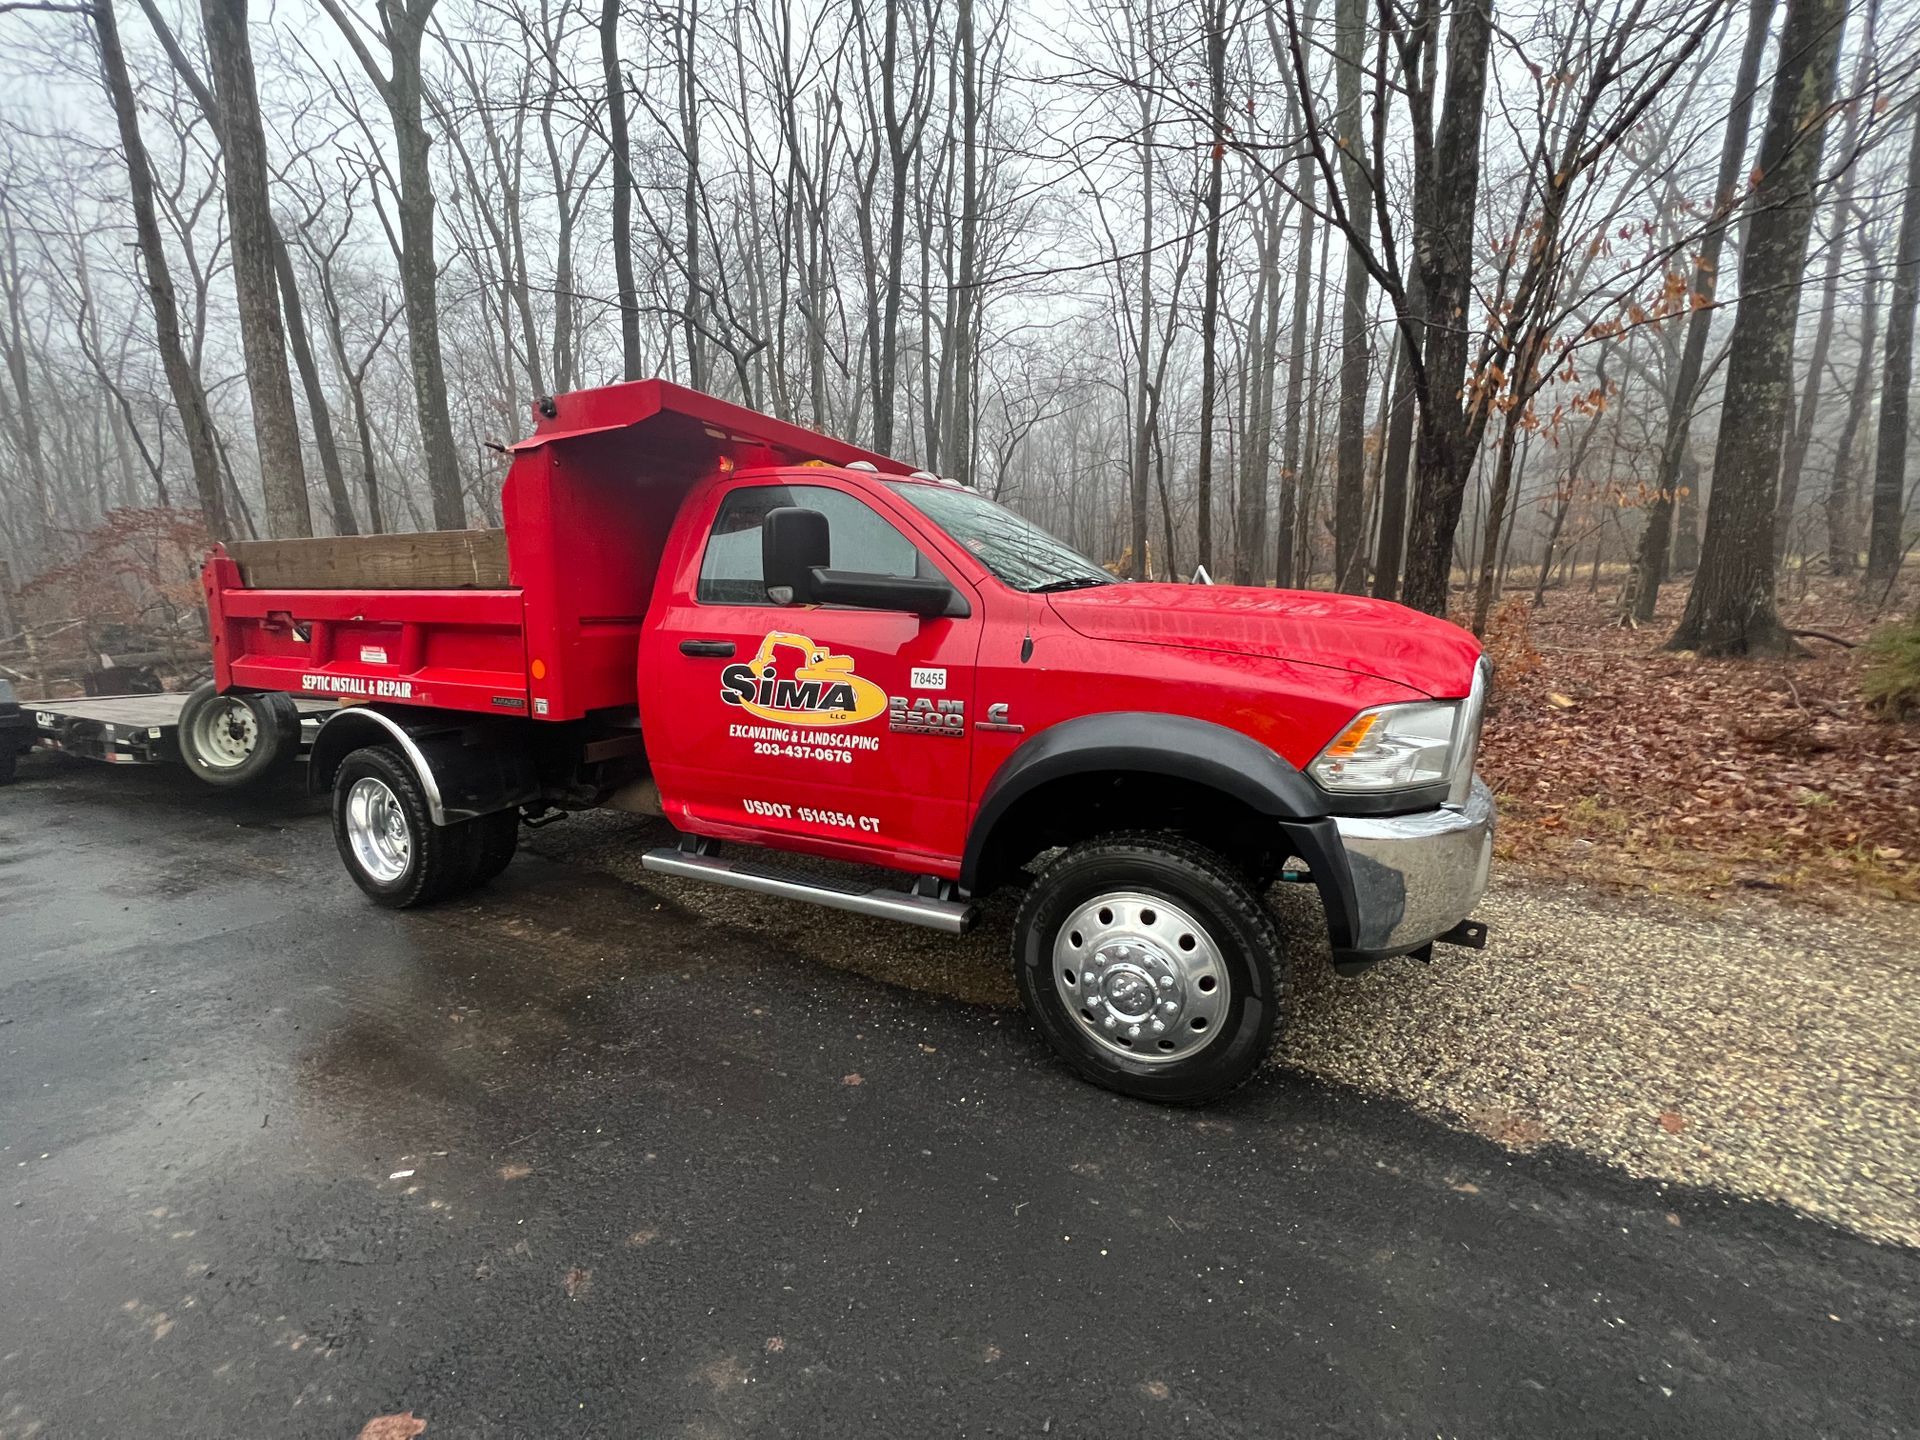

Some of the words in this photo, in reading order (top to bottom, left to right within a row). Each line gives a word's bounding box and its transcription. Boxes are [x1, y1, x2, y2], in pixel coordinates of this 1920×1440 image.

[302, 674, 330, 691] SEPTIC
[331, 676, 366, 694] INSTALL
[368, 680, 375, 695] &
[377, 681, 412, 698] REPAIR
[914, 672, 944, 685] 78455
[889, 696, 964, 714] RAM
[889, 709, 964, 728] 5500
[729, 724, 789, 742] EXCAVATING
[791, 731, 798, 743] &
[801, 732, 879, 751] LANDSCAPING
[754, 742, 852, 763] 203-437-0676
[743, 799, 792, 819] USDOT
[797, 807, 856, 828] 1514354
[859, 816, 880, 832] CT
